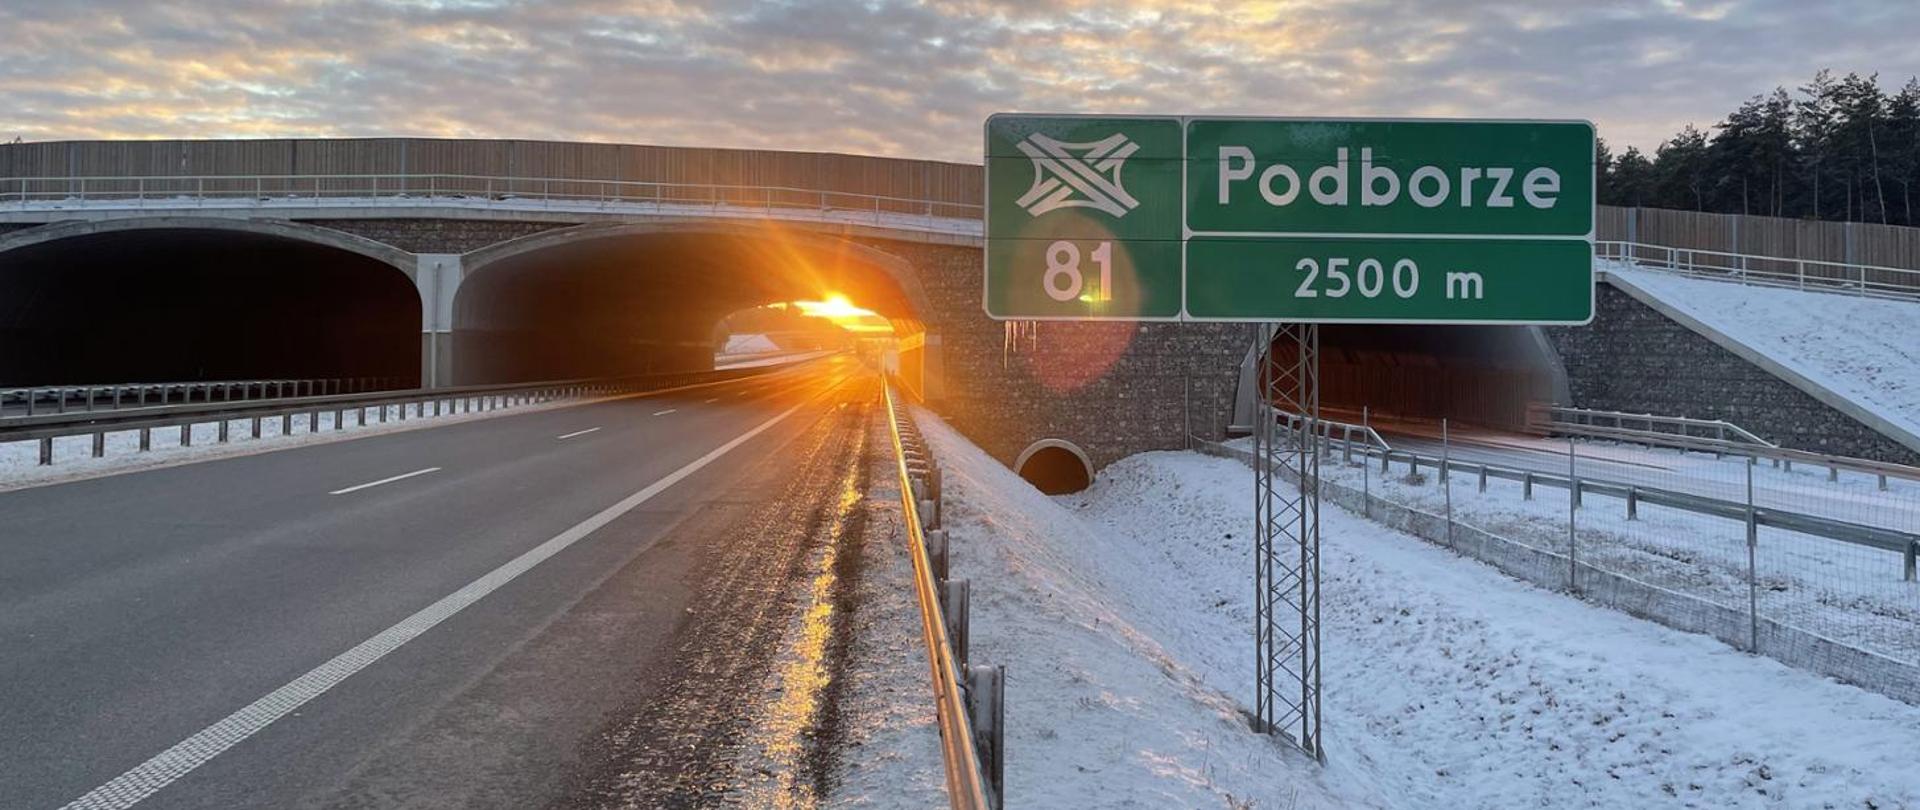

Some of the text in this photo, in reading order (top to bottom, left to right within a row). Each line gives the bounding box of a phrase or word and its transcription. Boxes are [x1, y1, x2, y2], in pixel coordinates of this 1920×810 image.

[1218, 146, 1561, 209] Podborze
[1043, 240, 1113, 302] 81
[1295, 258, 1484, 299] 2500 m
